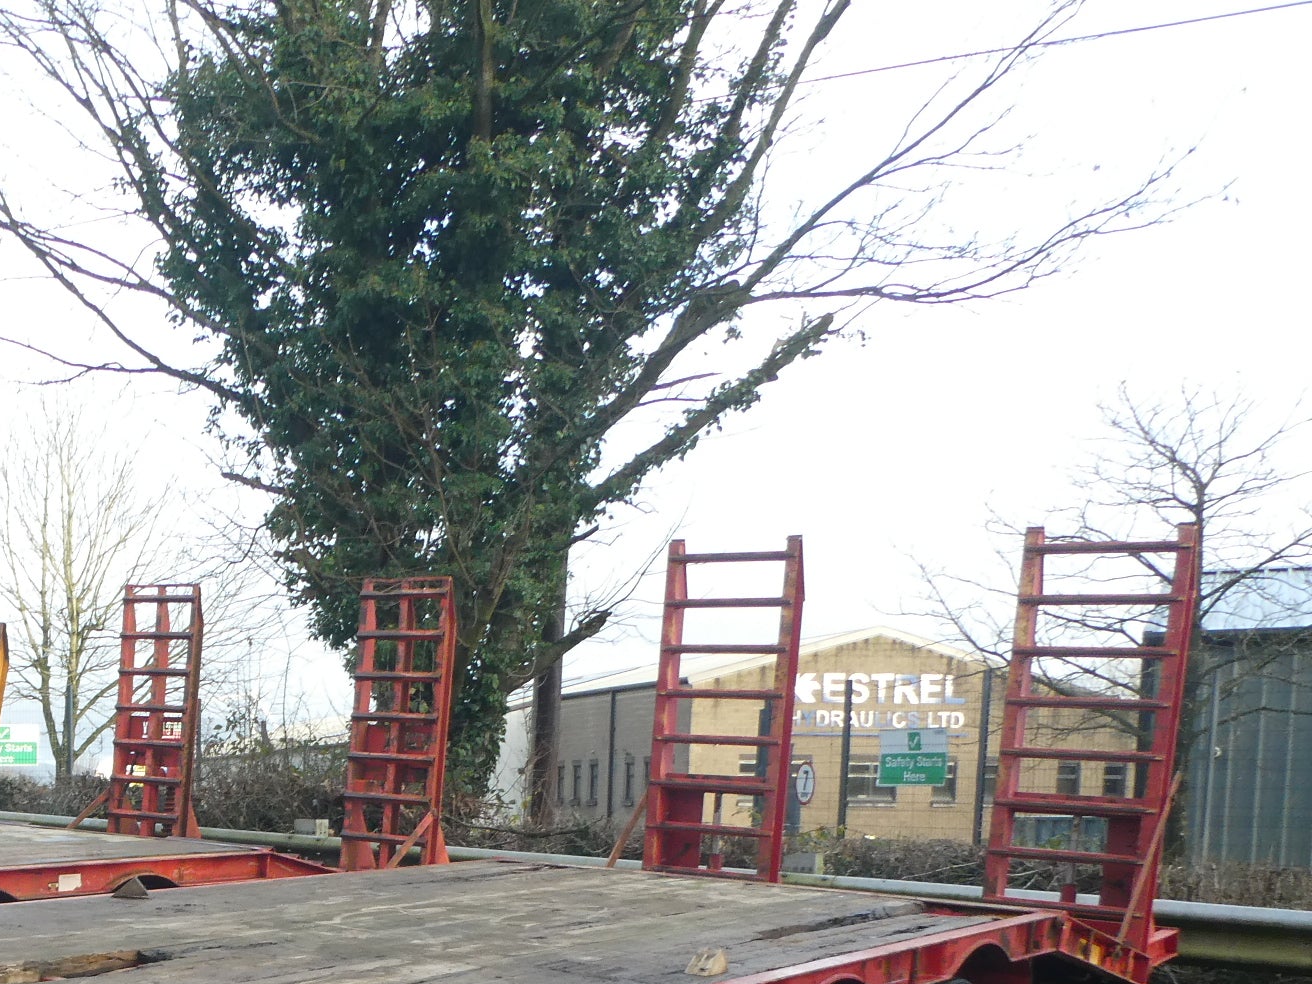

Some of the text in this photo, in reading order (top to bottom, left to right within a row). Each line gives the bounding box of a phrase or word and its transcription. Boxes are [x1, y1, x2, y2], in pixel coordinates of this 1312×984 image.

[795, 672, 966, 704] KESTREL
[927, 711, 965, 729] LTD
[885, 756, 942, 770] Safety Starts
[903, 770, 926, 781] Here
